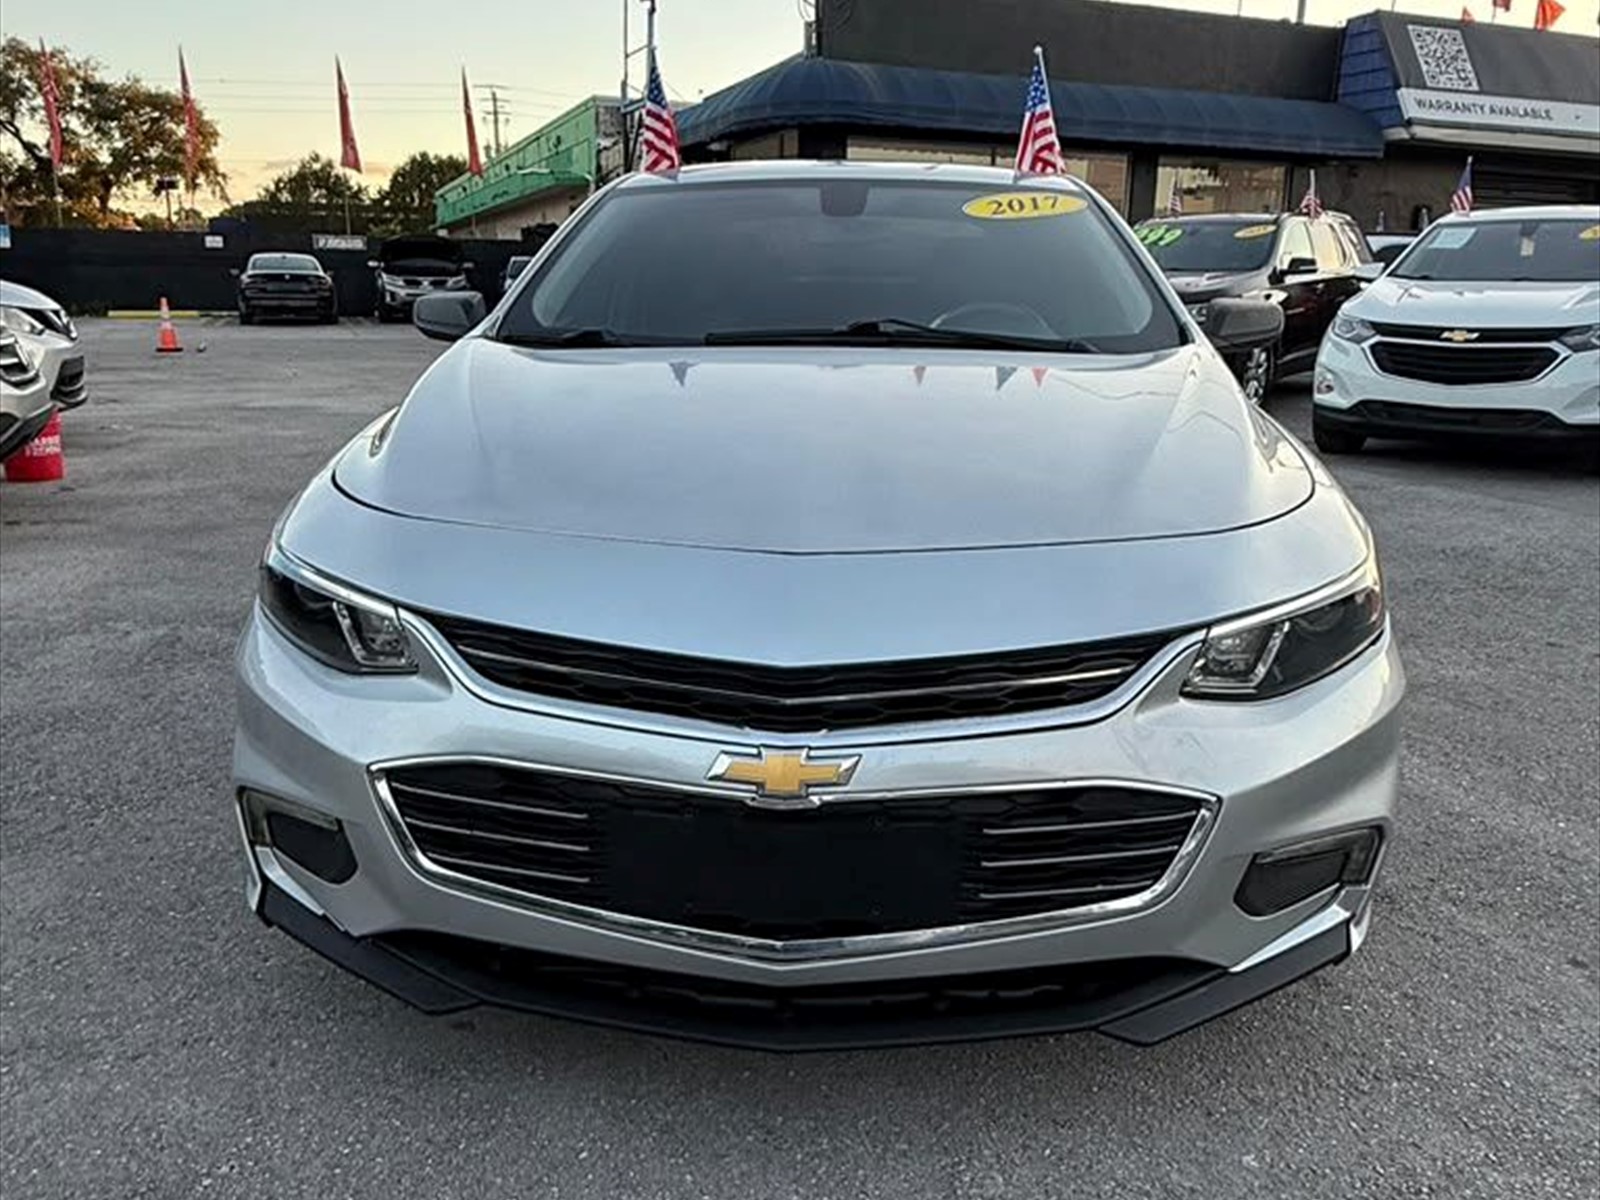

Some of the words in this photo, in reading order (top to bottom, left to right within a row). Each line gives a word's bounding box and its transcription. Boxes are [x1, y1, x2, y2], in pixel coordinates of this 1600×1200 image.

[1414, 97, 1485, 114] WARRANTY
[1489, 103, 1553, 121] AVAILABLE
[986, 195, 1058, 216] 2017
